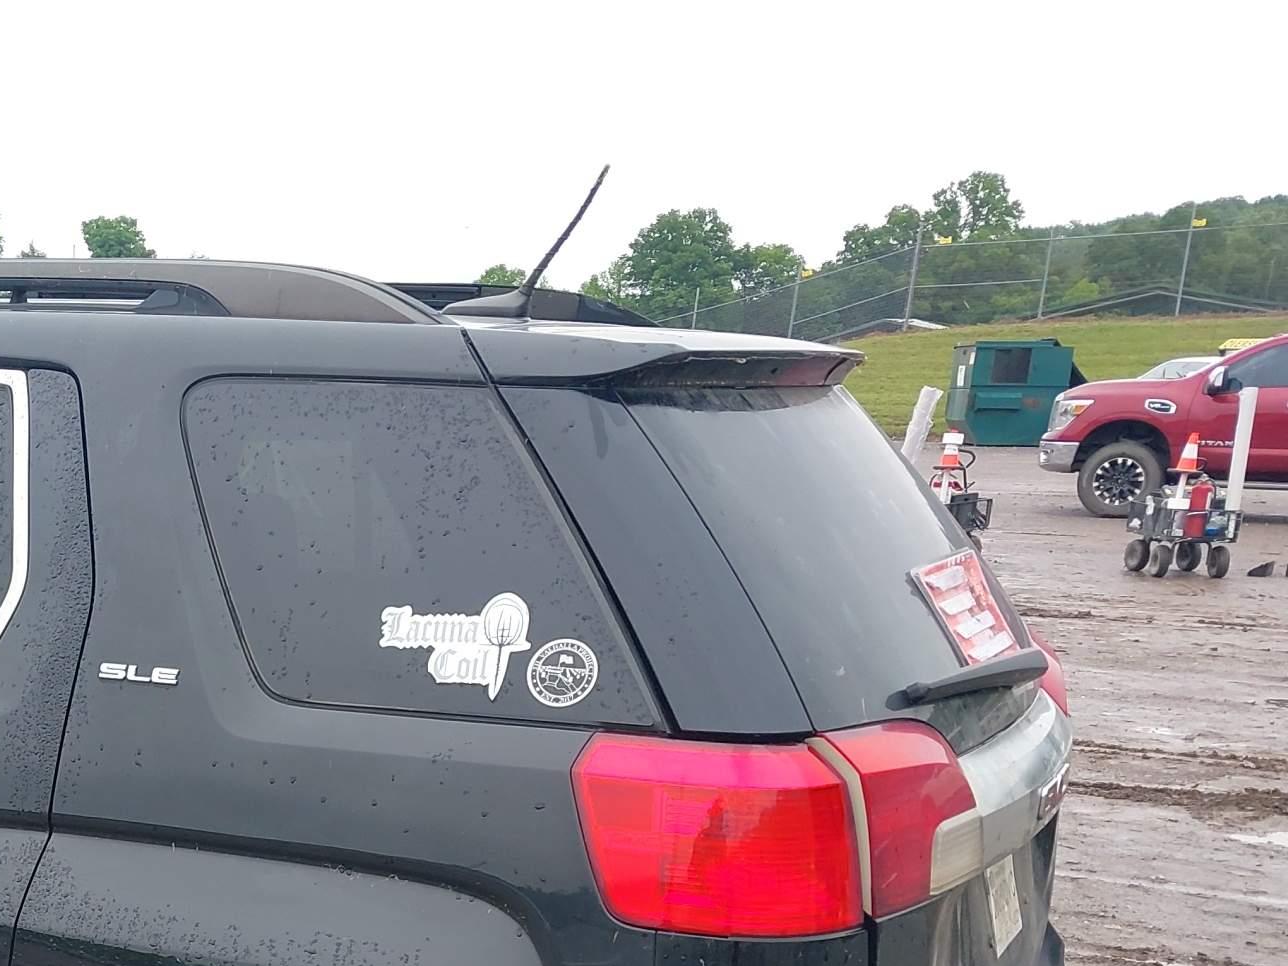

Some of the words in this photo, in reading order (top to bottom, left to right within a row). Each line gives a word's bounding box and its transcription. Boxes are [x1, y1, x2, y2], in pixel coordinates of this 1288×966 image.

[385, 611, 480, 643] Lacuna
[98, 662, 179, 684] SLE
[433, 649, 489, 680] Coil
